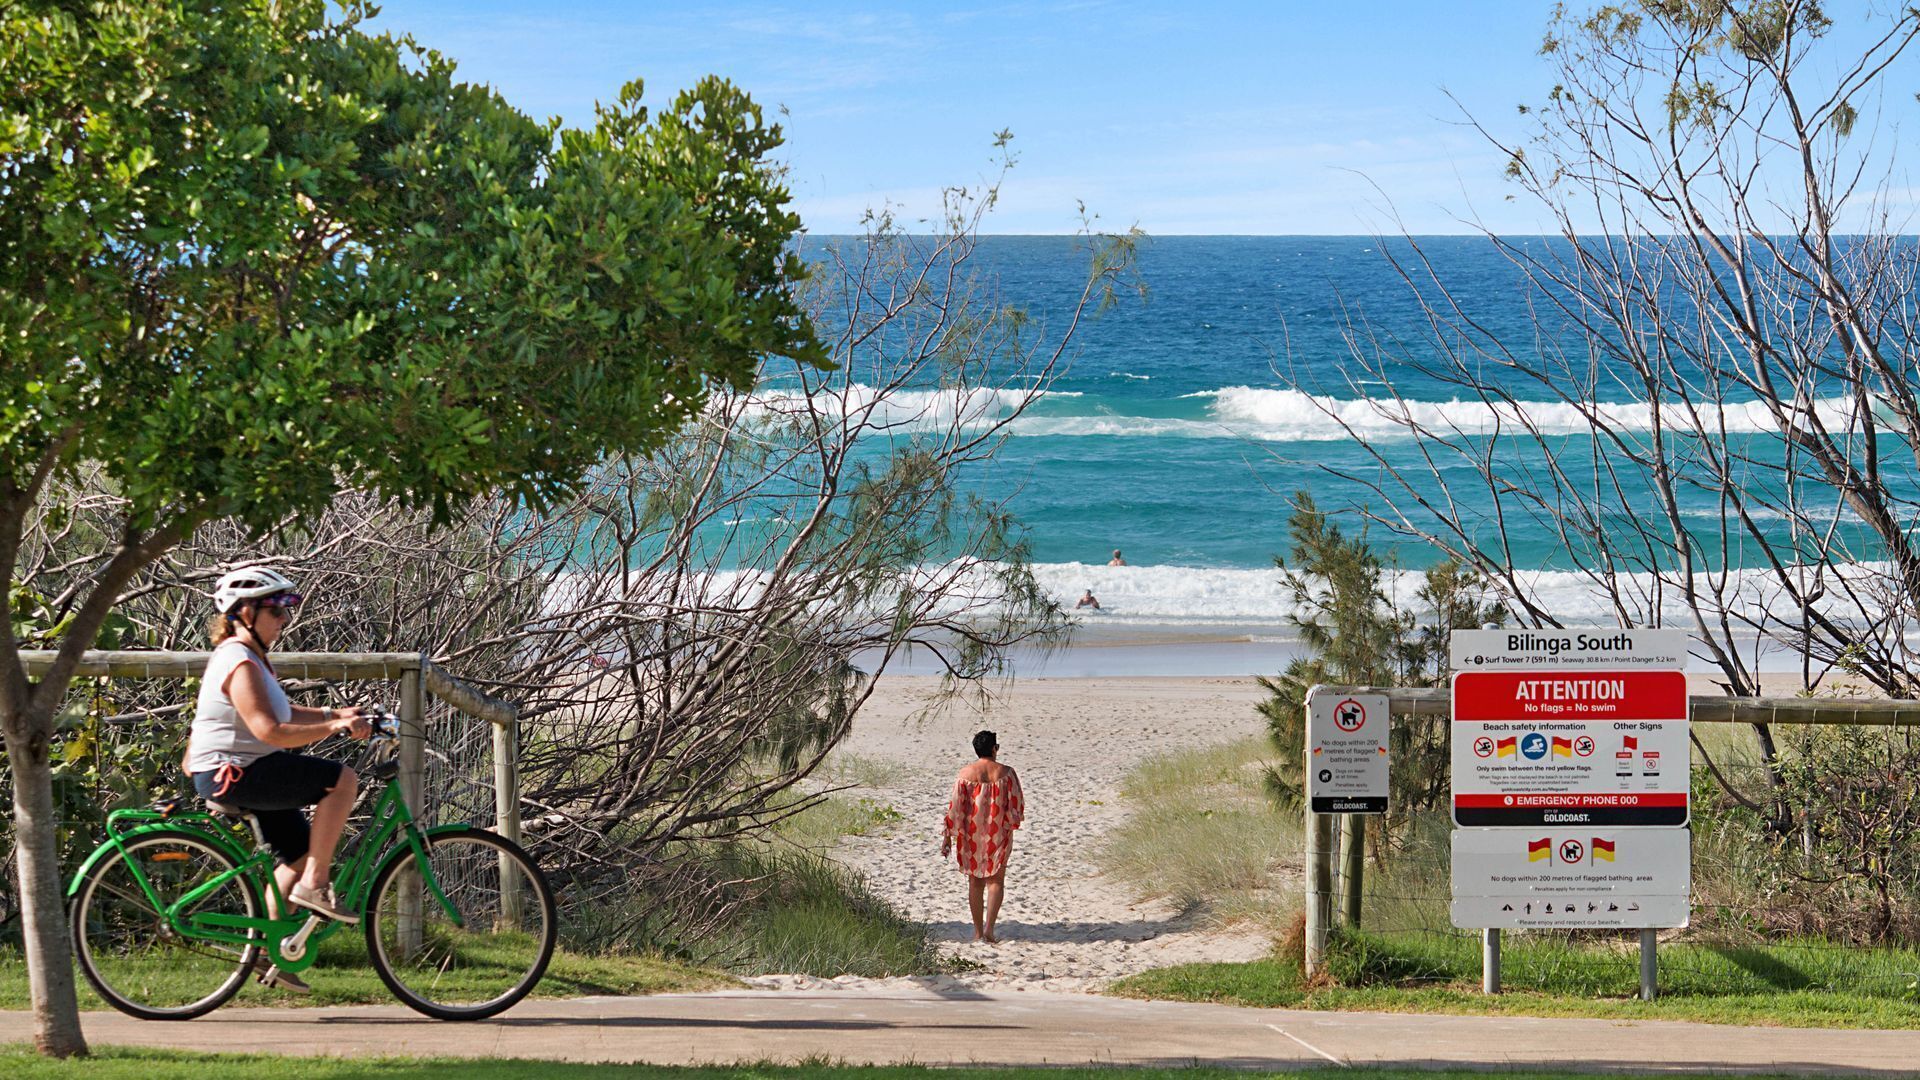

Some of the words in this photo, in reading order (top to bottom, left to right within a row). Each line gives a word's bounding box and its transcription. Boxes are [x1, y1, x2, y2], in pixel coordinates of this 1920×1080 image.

[1508, 634, 1571, 655] Bilinga
[1577, 634, 1633, 651] South
[1531, 656, 1546, 664] (591
[1548, 656, 1559, 664] m)
[1562, 656, 1585, 664] Seaway
[1632, 656, 1654, 664] Danger
[1515, 680, 1625, 700] ATTENTION
[1525, 703, 1538, 712] No
[1540, 703, 1564, 714] flags
[1575, 703, 1588, 712] No
[1591, 703, 1616, 712] swim
[1483, 723, 1509, 731] Beach
[1511, 723, 1537, 732] safety
[1539, 723, 1586, 731] information
[1613, 722, 1637, 730] Other
[1639, 722, 1663, 731] Signs
[1353, 748, 1376, 756] flagged
[1329, 756, 1353, 764] bathing
[1517, 796, 1580, 805] EMERGENCY
[1583, 796, 1618, 805] PHONE
[1620, 796, 1638, 805] 000
[1501, 875, 1517, 883] dogs
[1583, 875, 1607, 883] flagged
